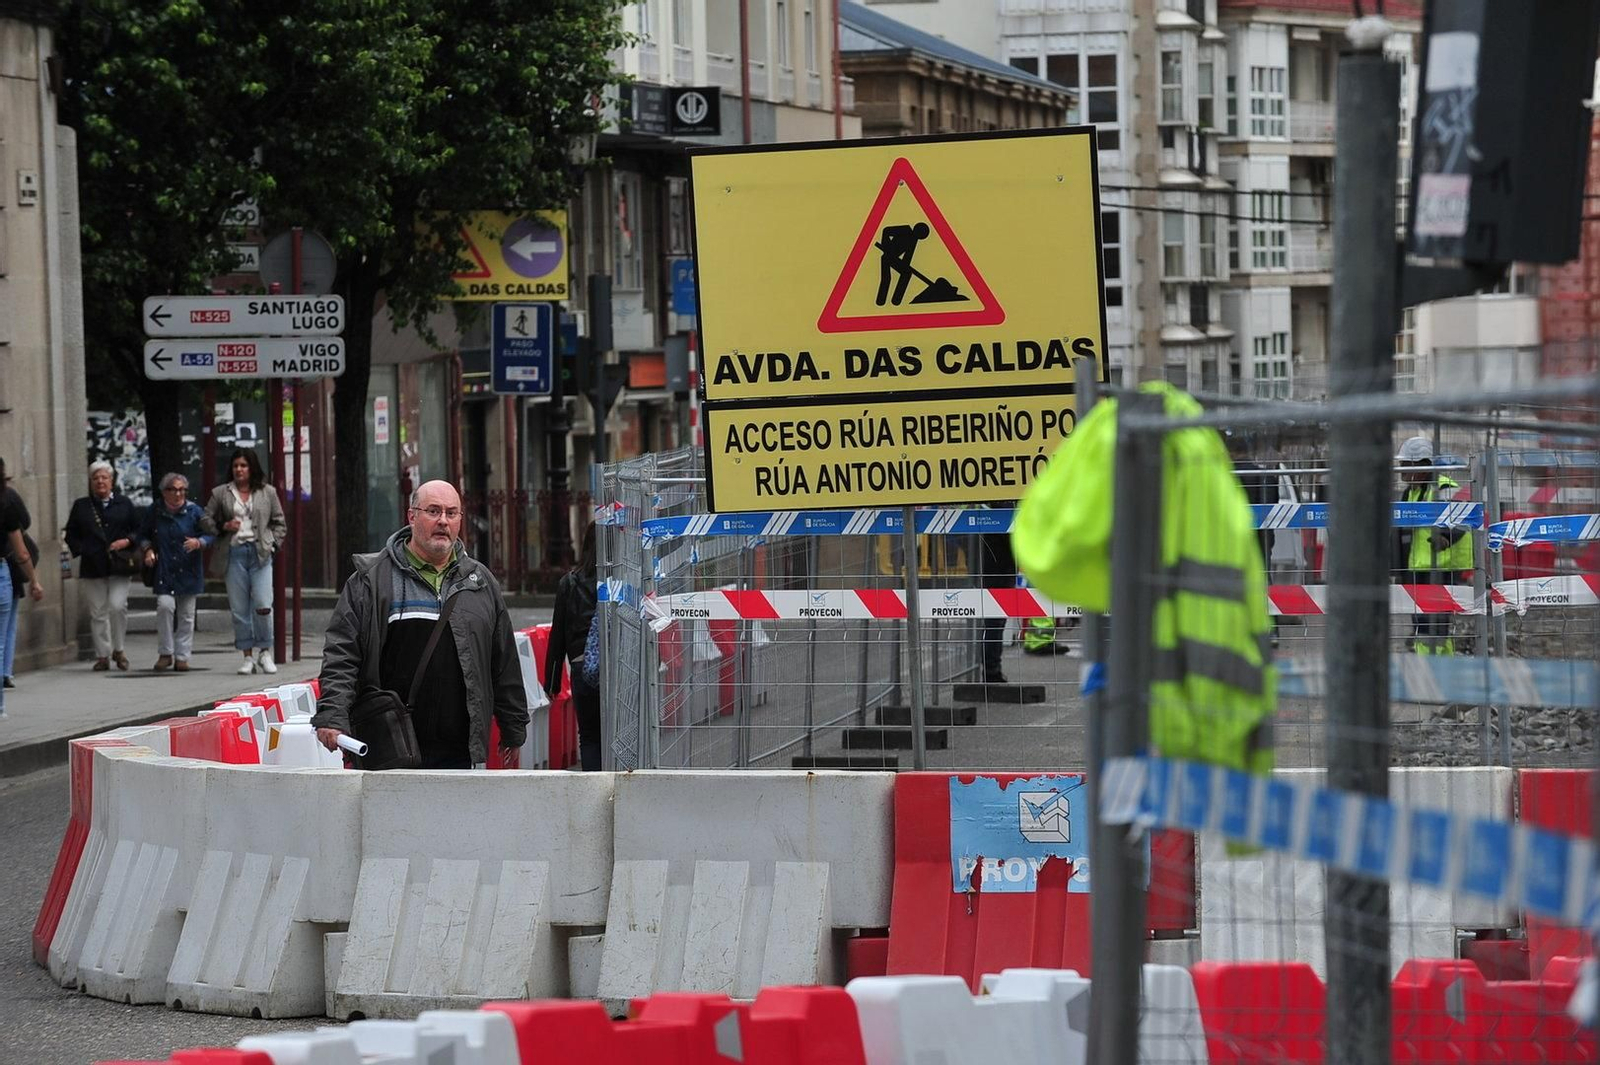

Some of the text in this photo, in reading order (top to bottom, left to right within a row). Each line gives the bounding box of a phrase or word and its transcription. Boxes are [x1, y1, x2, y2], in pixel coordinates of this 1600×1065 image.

[470, 283, 566, 296] DAS CALDAS
[248, 301, 339, 315] SANTIAGO
[192, 311, 229, 322] N-525
[292, 316, 340, 330] LUGO
[219, 345, 255, 356] N-120
[299, 343, 340, 357] VIGO
[183, 354, 212, 365] A-52
[273, 358, 340, 373] MADRID
[714, 337, 1096, 385] AVDA. DAS CALDAS
[219, 362, 256, 372] N-525
[726, 405, 1077, 454] ACCESO RÚA RIBEIRIÑO PO
[756, 446, 1050, 496] RÚA ANTONIO MORETÓ
[670, 609, 710, 617] PROYECON
[799, 608, 842, 617] PROYECON
[931, 607, 976, 616] PROYECON
